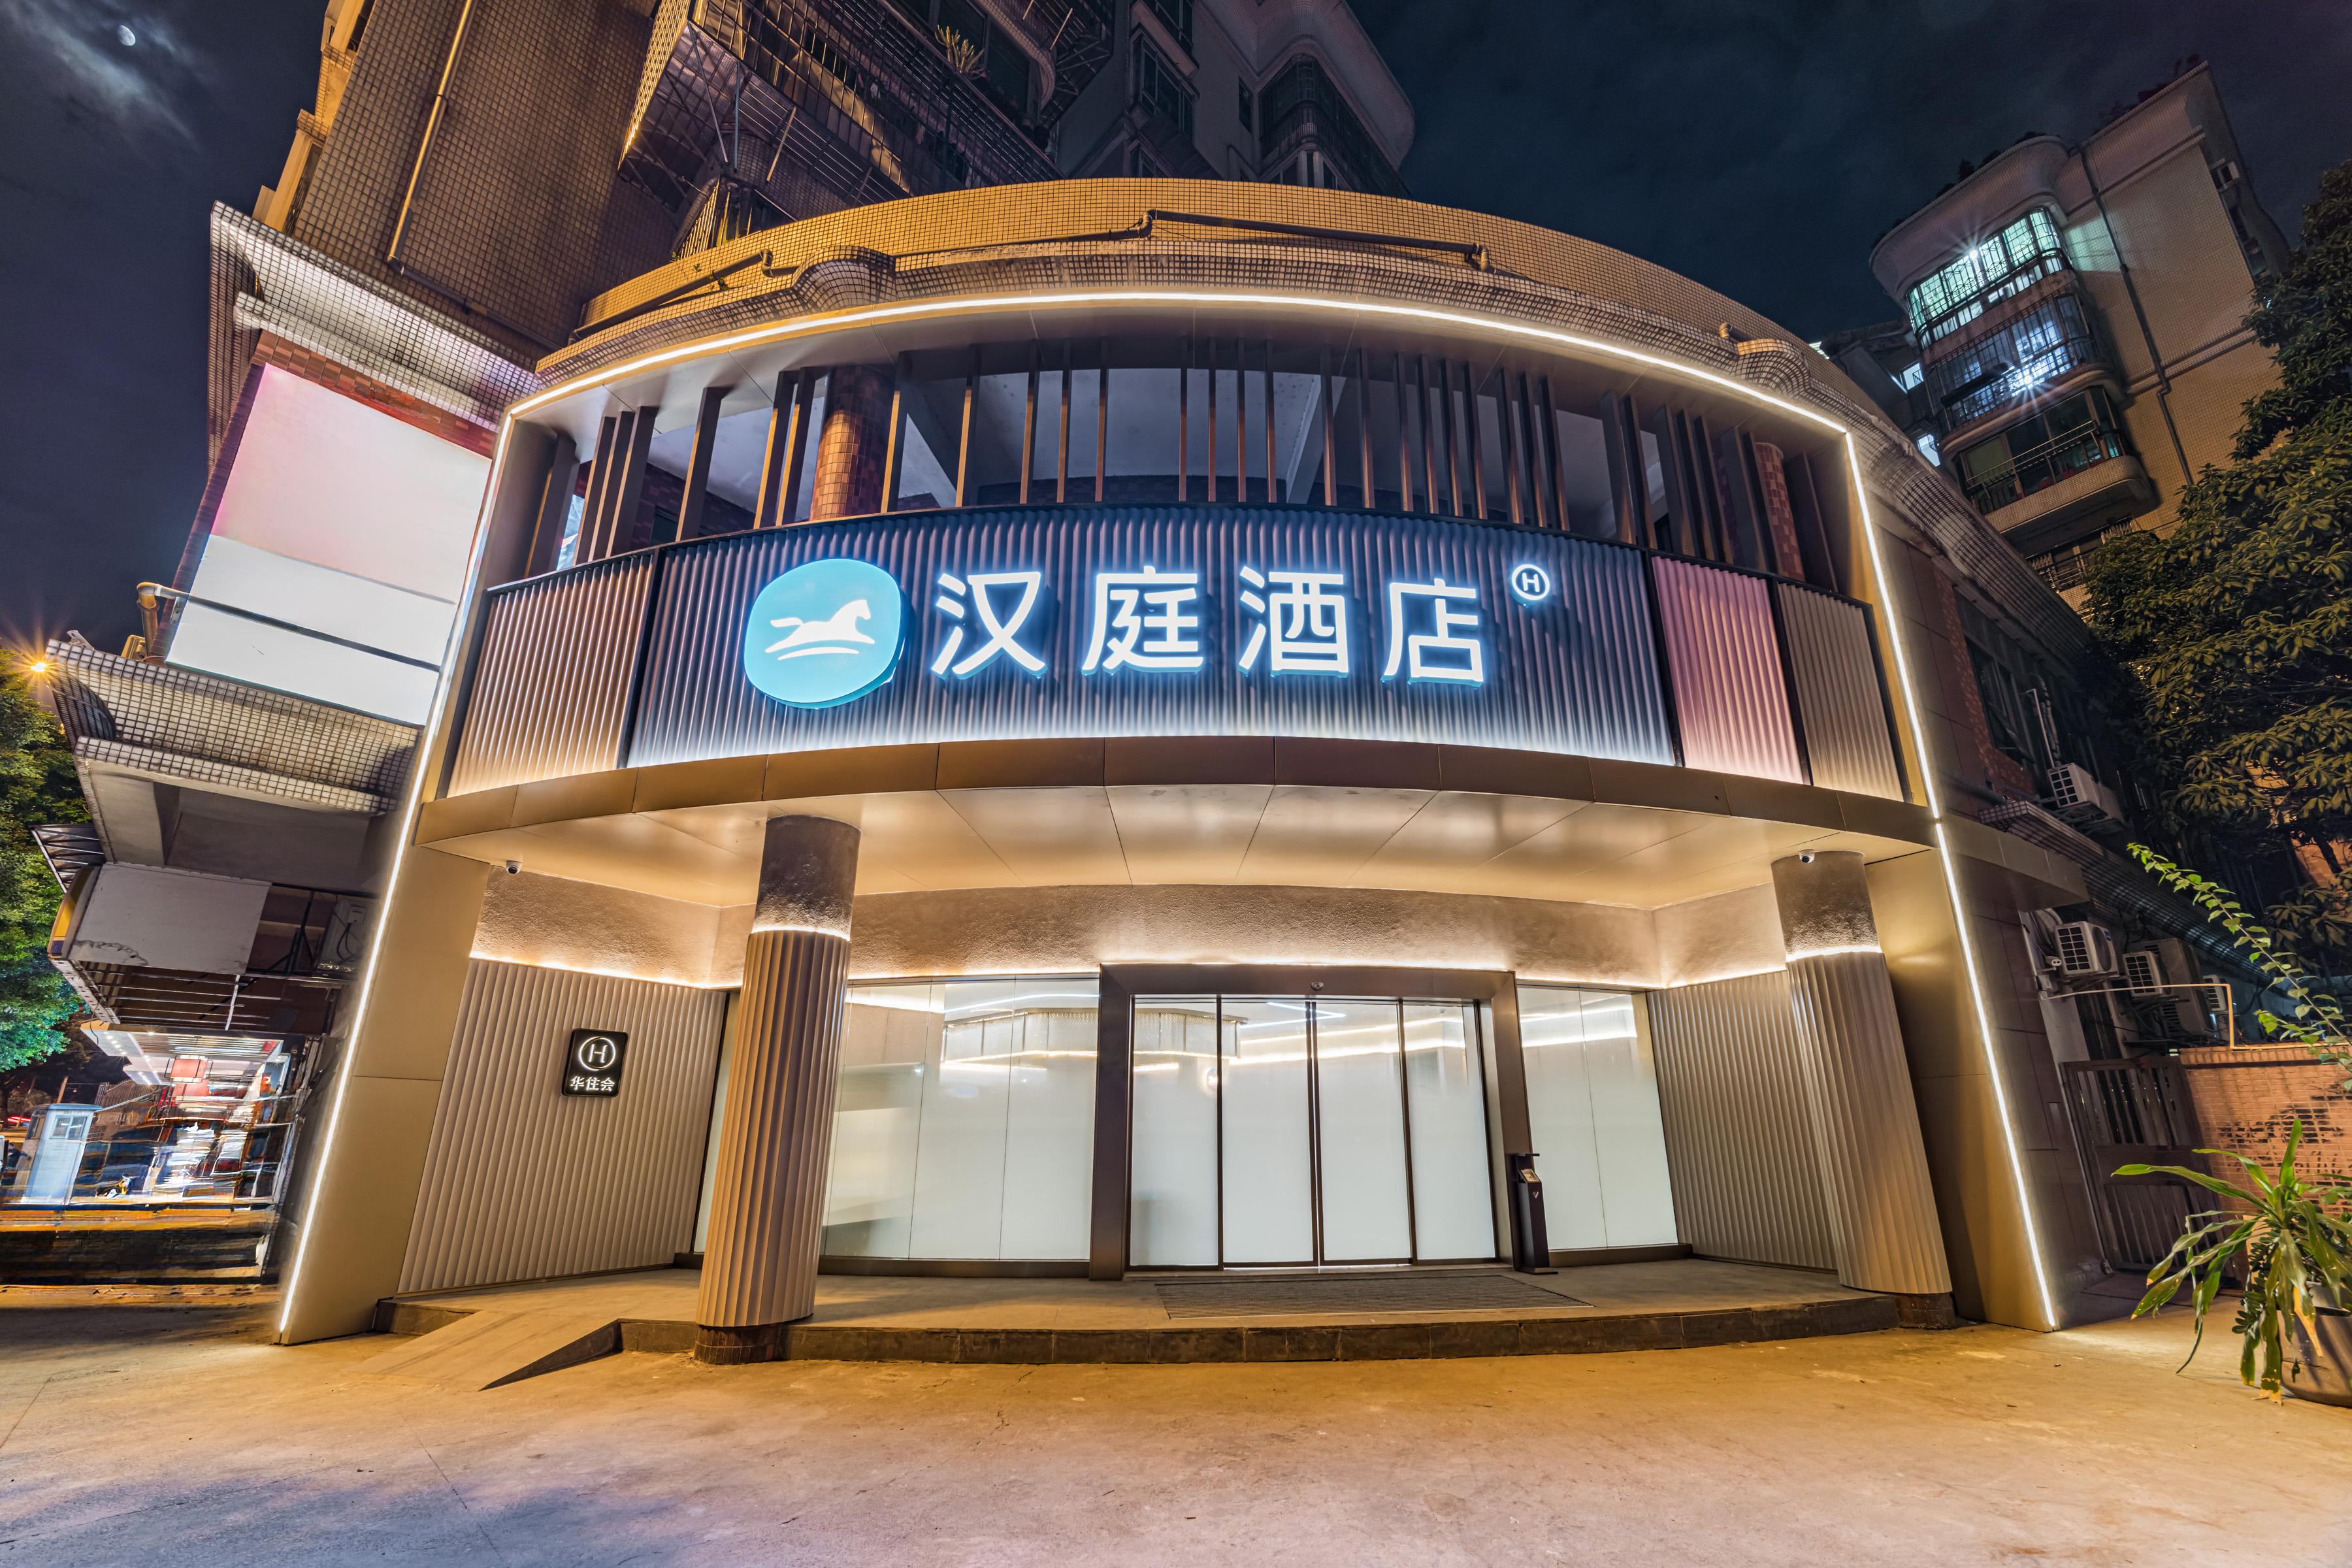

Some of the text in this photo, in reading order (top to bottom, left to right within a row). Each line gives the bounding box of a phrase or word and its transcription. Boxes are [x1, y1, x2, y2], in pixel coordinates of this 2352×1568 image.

[930, 565, 1484, 685] 汉庭酒店
[570, 1075, 615, 1092] 华住会
